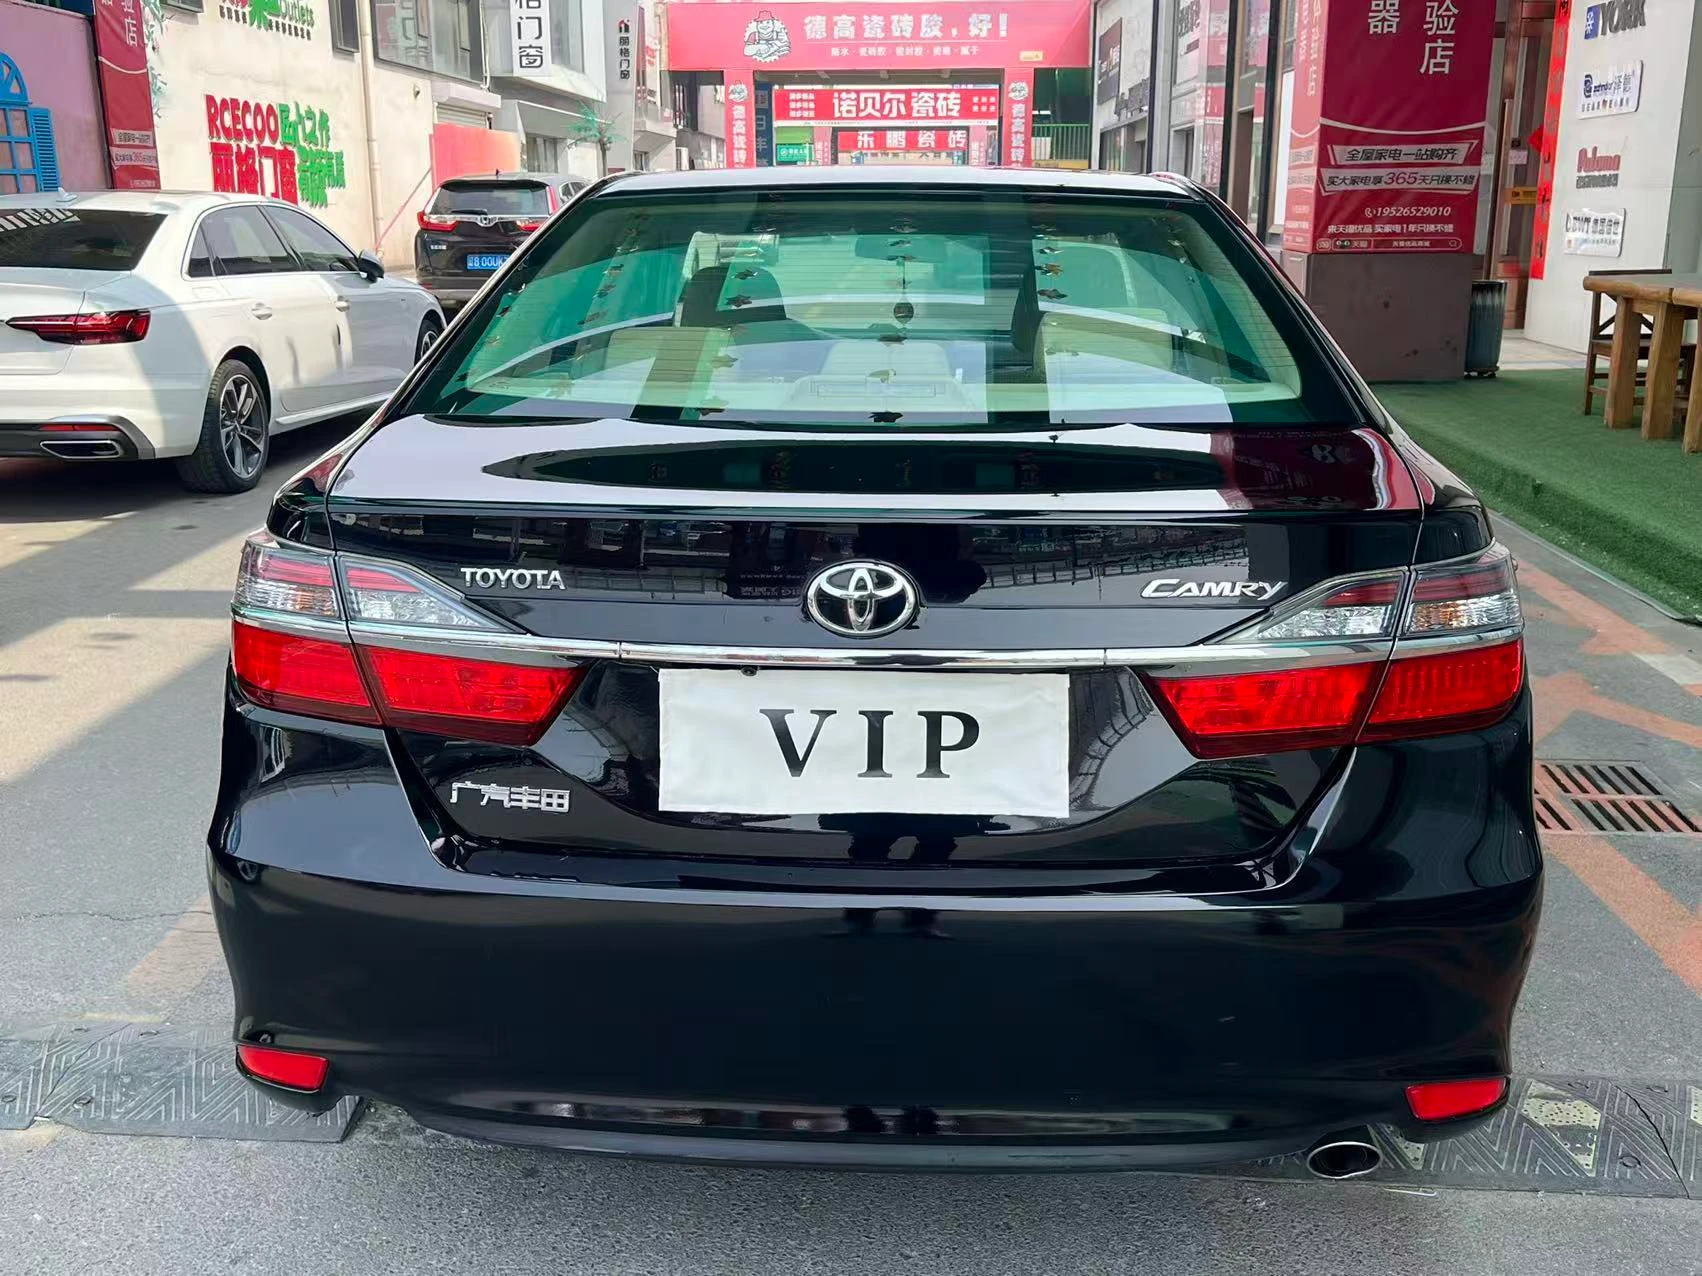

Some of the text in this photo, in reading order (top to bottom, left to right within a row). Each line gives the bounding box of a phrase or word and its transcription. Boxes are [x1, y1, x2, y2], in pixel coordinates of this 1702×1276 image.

[1600, 0, 1646, 36] YORK
[1420, 0, 1459, 74] 验店
[619, 36, 631, 80] 丽格门窗
[205, 93, 280, 145] RCECOO
[833, 92, 961, 118] 诺贝尔瓷砖
[1376, 206, 1451, 217] 19526529010
[460, 567, 566, 591] TOYOTA
[1141, 578, 1287, 601] CAMRY
[759, 708, 980, 779] VIP
[449, 780, 571, 813] 广汽丰田
